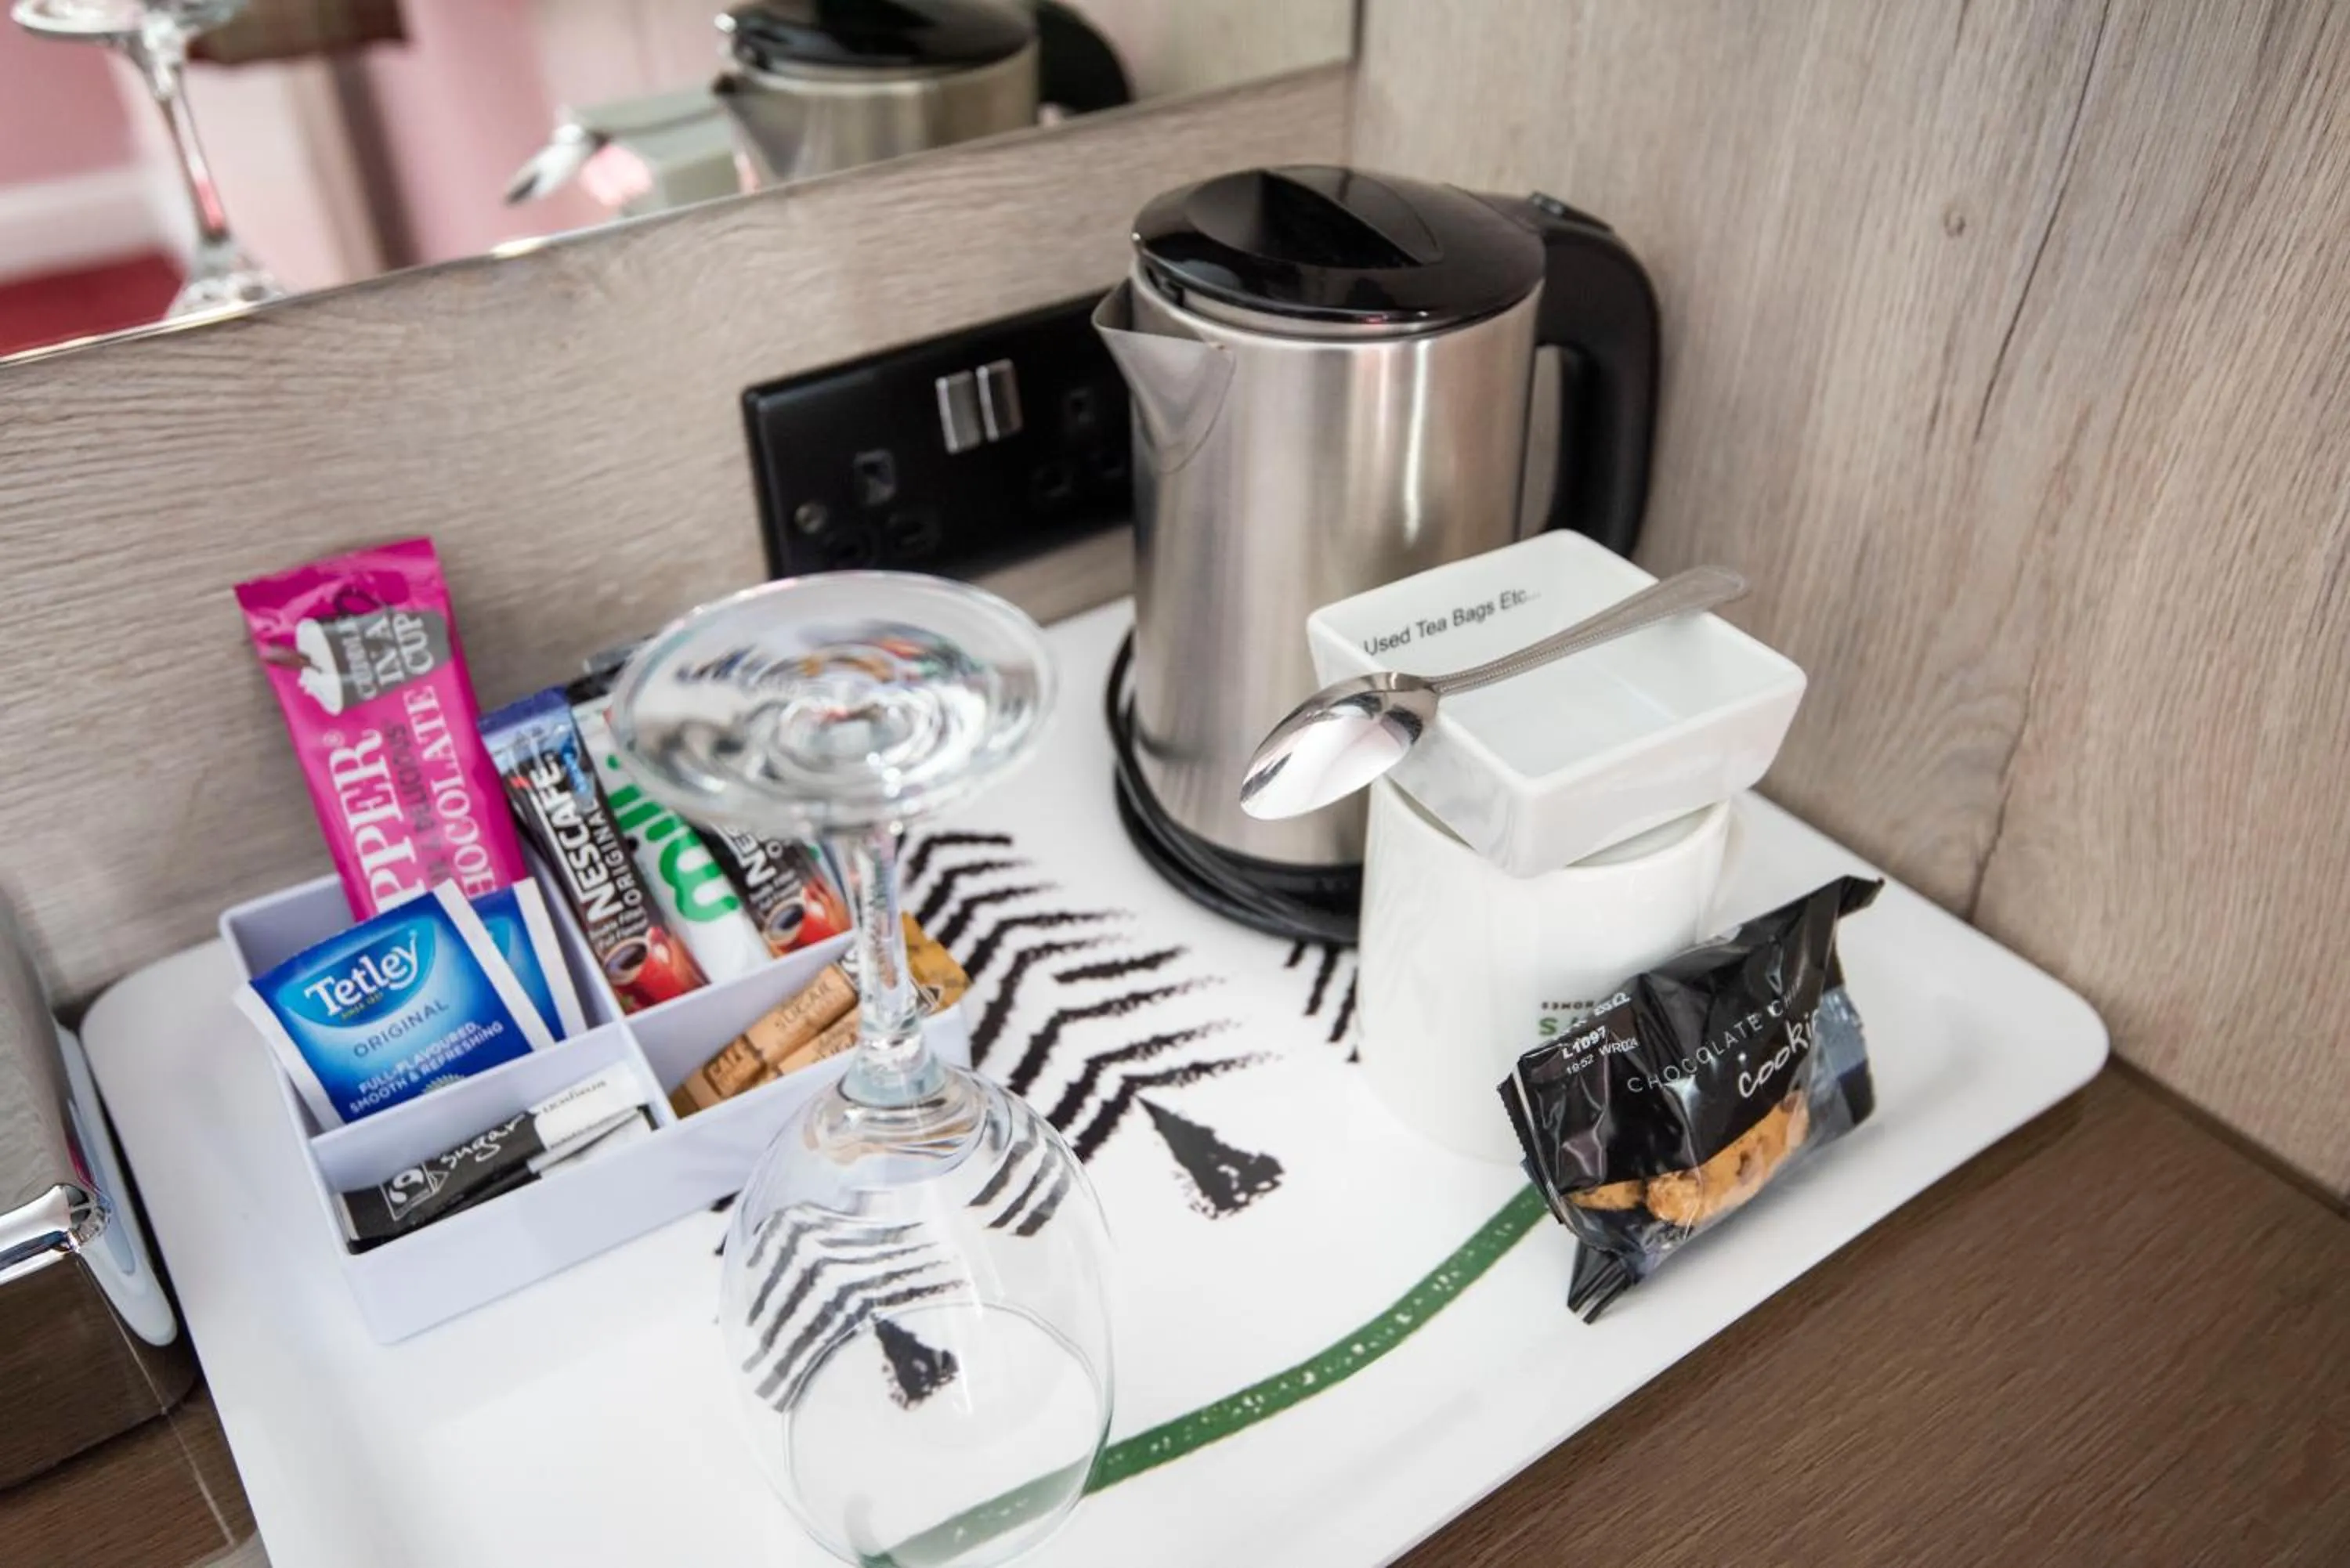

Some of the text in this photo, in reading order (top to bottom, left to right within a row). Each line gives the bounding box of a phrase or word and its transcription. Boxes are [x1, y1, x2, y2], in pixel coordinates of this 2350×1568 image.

[392, 613, 436, 676] CUP
[1363, 627, 1412, 657] Used
[1415, 615, 1448, 641] Tea
[1452, 601, 1497, 628] Bags
[328, 729, 427, 914] PPER
[403, 685, 499, 898] HOCOLATE
[586, 800, 642, 909] ORIGINAL
[304, 930, 422, 1017] Tetley
[349, 1021, 504, 1114] SMOOTH & REFRESHING
[354, 999, 450, 1058] ORIGINAL
[1628, 1012, 1763, 1093] CHOCOLATE
[439, 1113, 527, 1169] sugar
